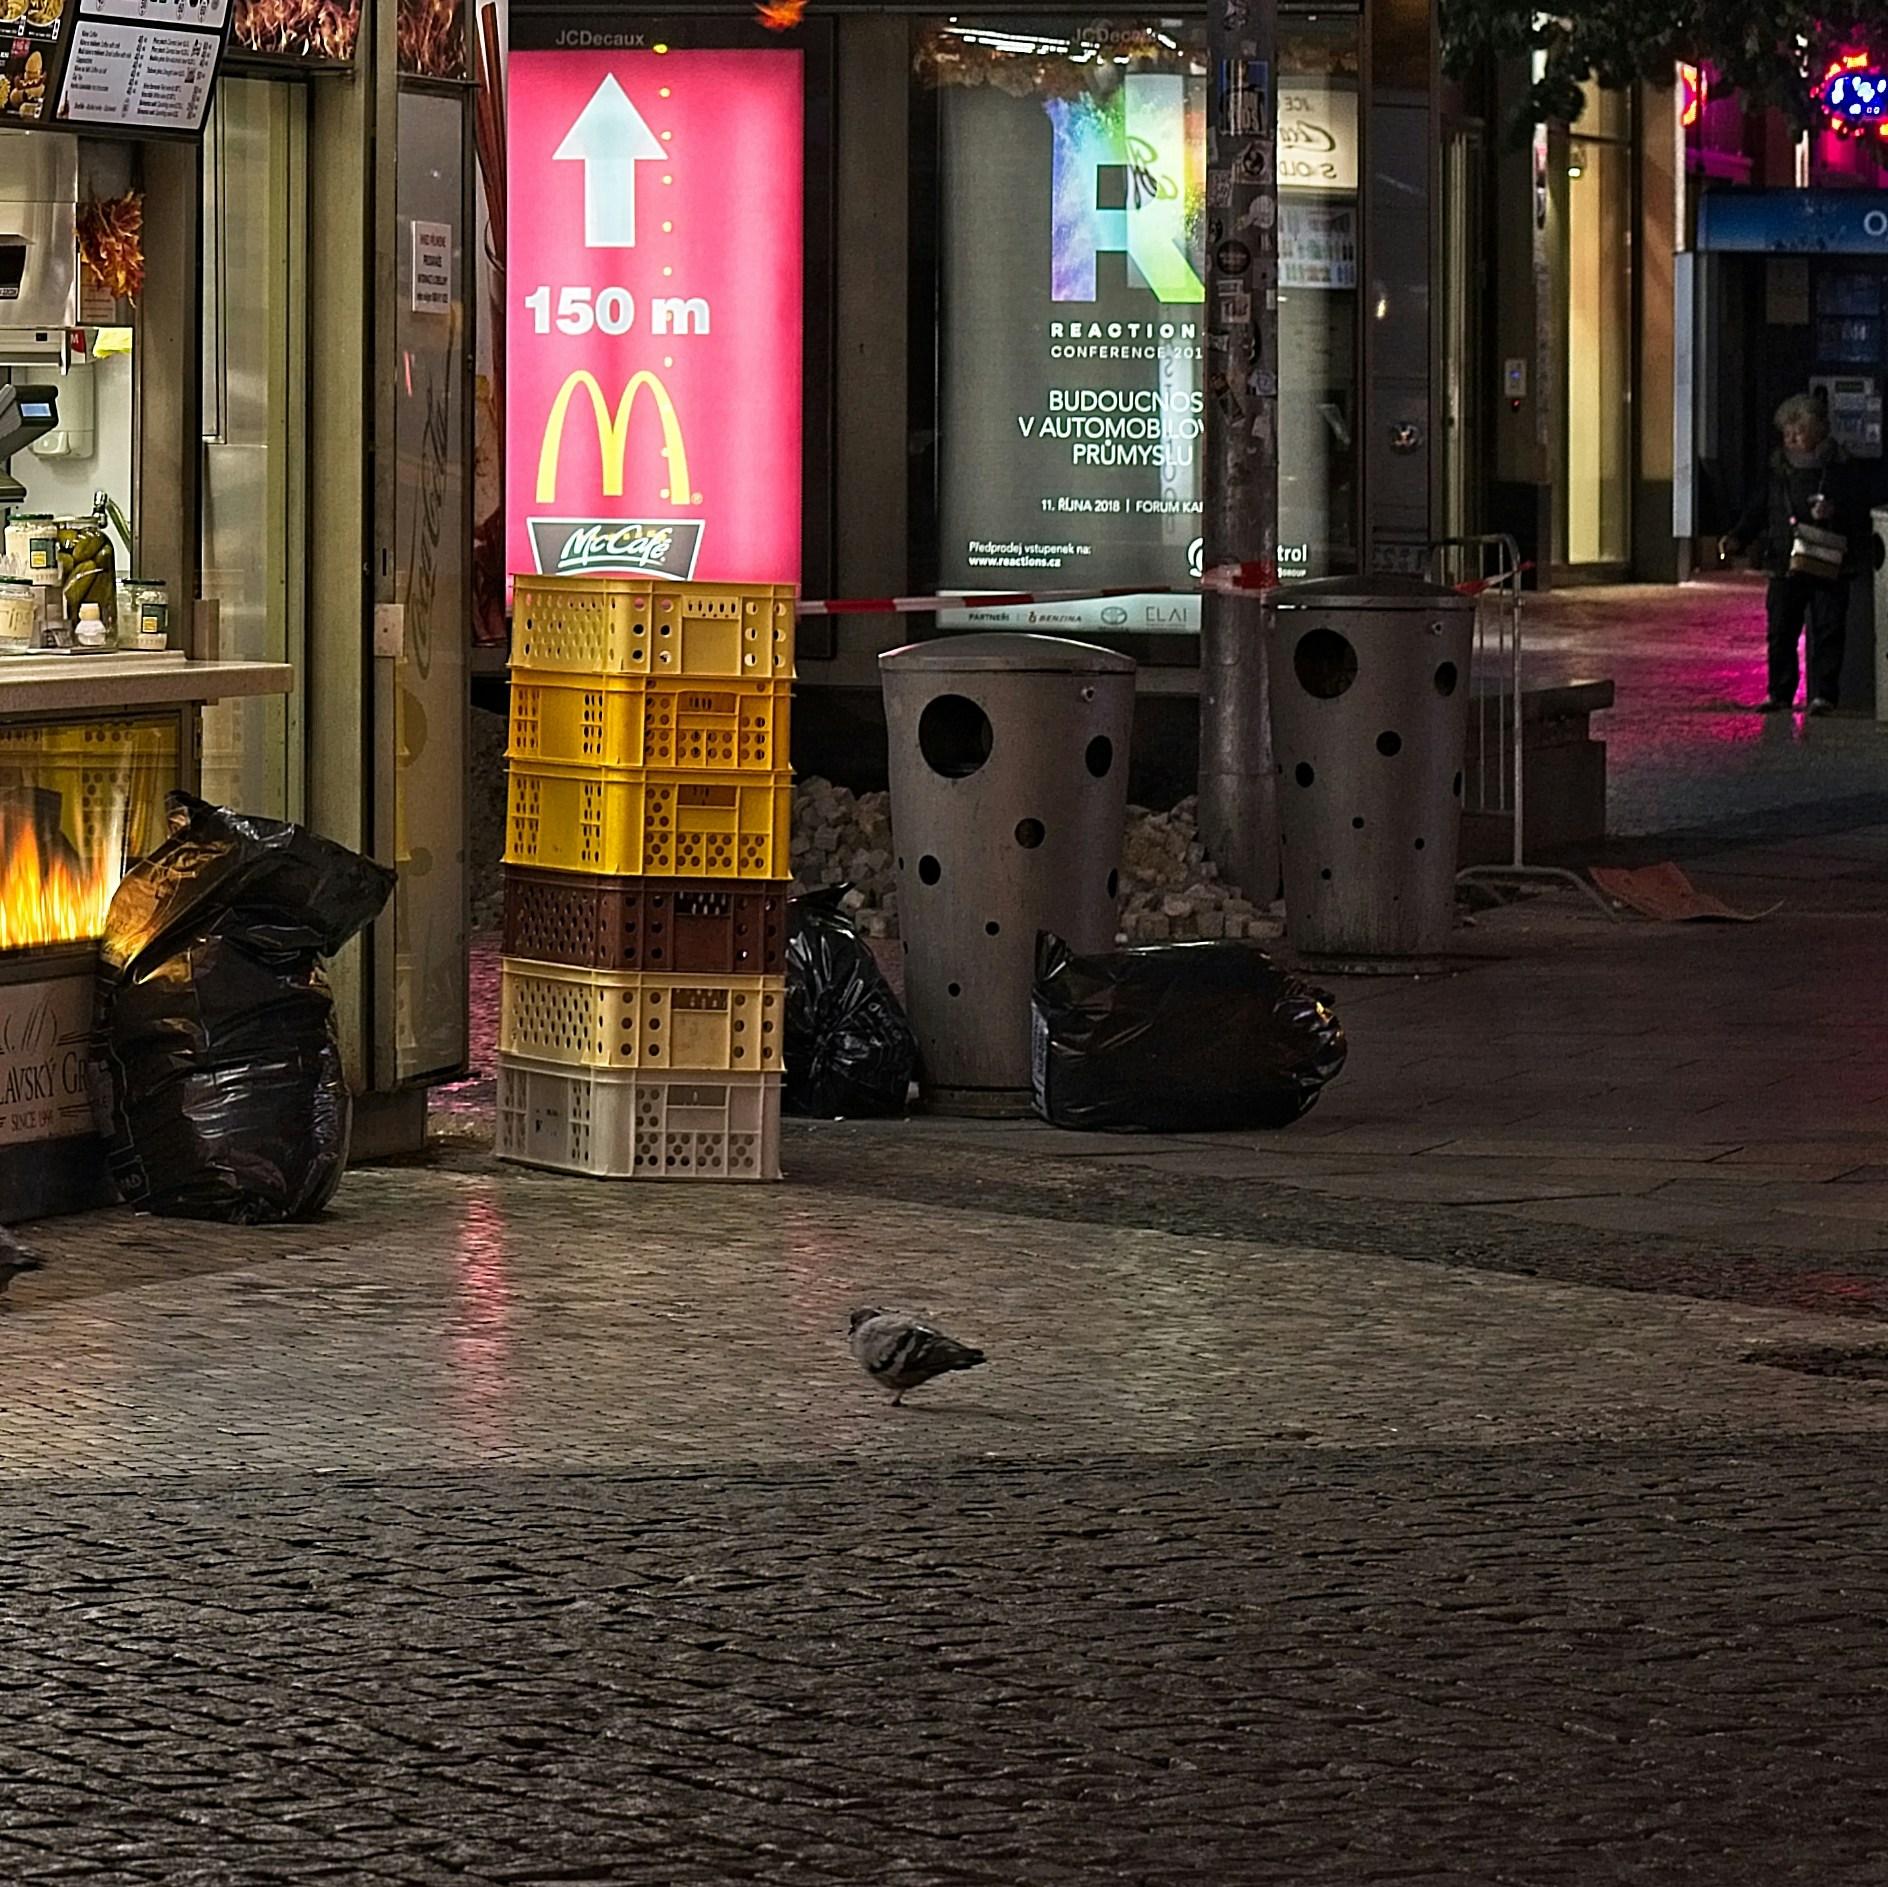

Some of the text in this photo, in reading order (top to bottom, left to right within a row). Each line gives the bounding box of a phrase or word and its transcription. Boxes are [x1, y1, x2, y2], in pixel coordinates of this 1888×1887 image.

[555, 30, 644, 46] JCDecaux
[525, 286, 710, 335] 150 m
[1051, 346, 1203, 359] CONFERENCE 201
[1049, 390, 1203, 412] BUDOUCNOS
[1019, 417, 1034, 437] V
[1073, 439, 1193, 465] PRŮMYSLU
[1041, 497, 1180, 513] 11. ŘÍJNA 2018 FORUM
[557, 524, 673, 568] McCafé
[1024, 543, 1074, 555] vstupenek
[968, 556, 1062, 567] www.reactions.cz
